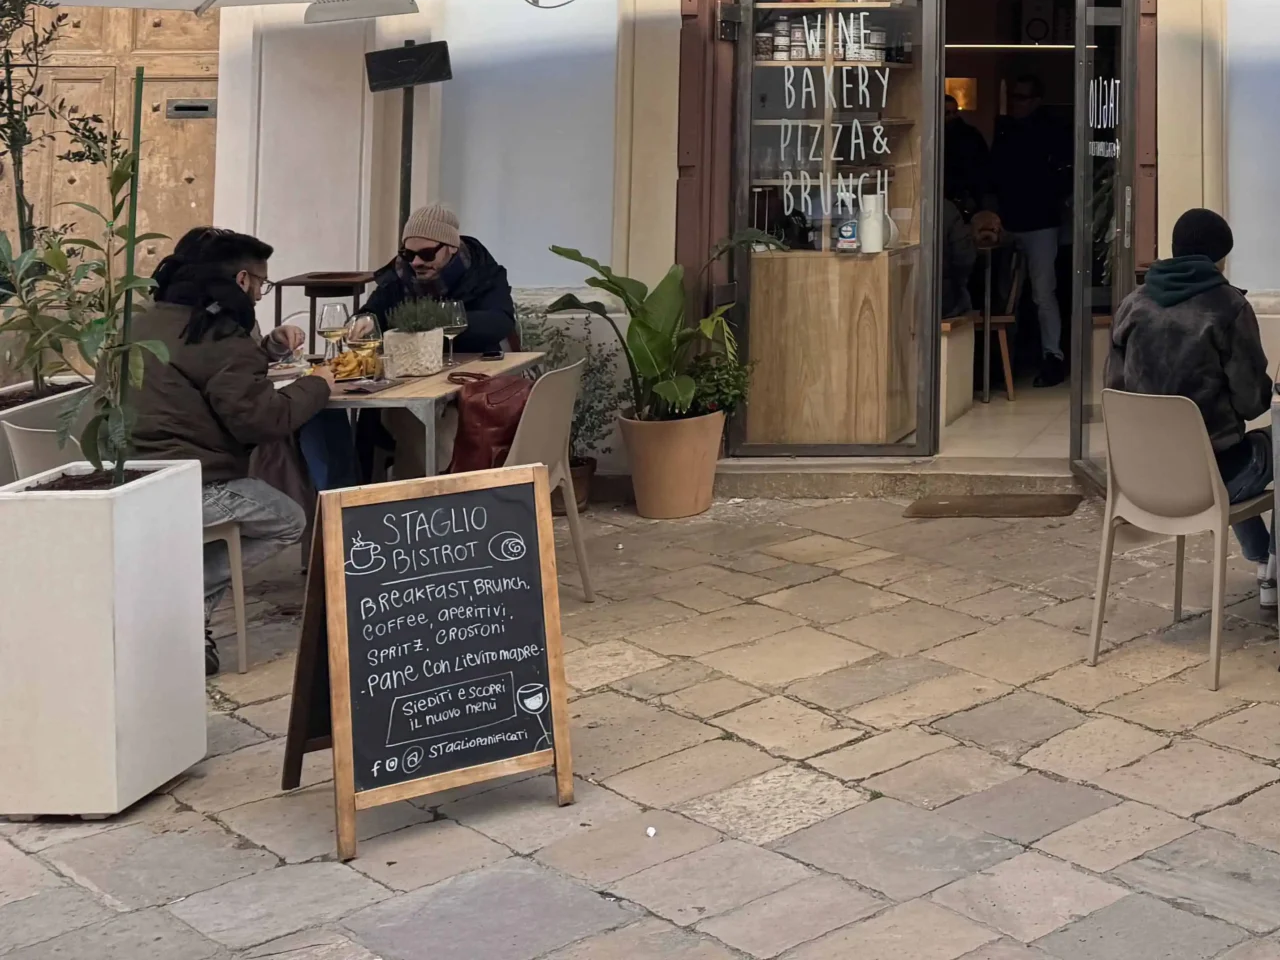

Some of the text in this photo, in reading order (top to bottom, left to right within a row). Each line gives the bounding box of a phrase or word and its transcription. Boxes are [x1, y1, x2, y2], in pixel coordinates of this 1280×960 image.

[802, 11, 872, 57] WINE
[783, 63, 890, 110] BAKERY
[782, 169, 889, 217] BRUNCH
[383, 506, 488, 545] STAGLIO
[393, 541, 480, 574] BISTROT
